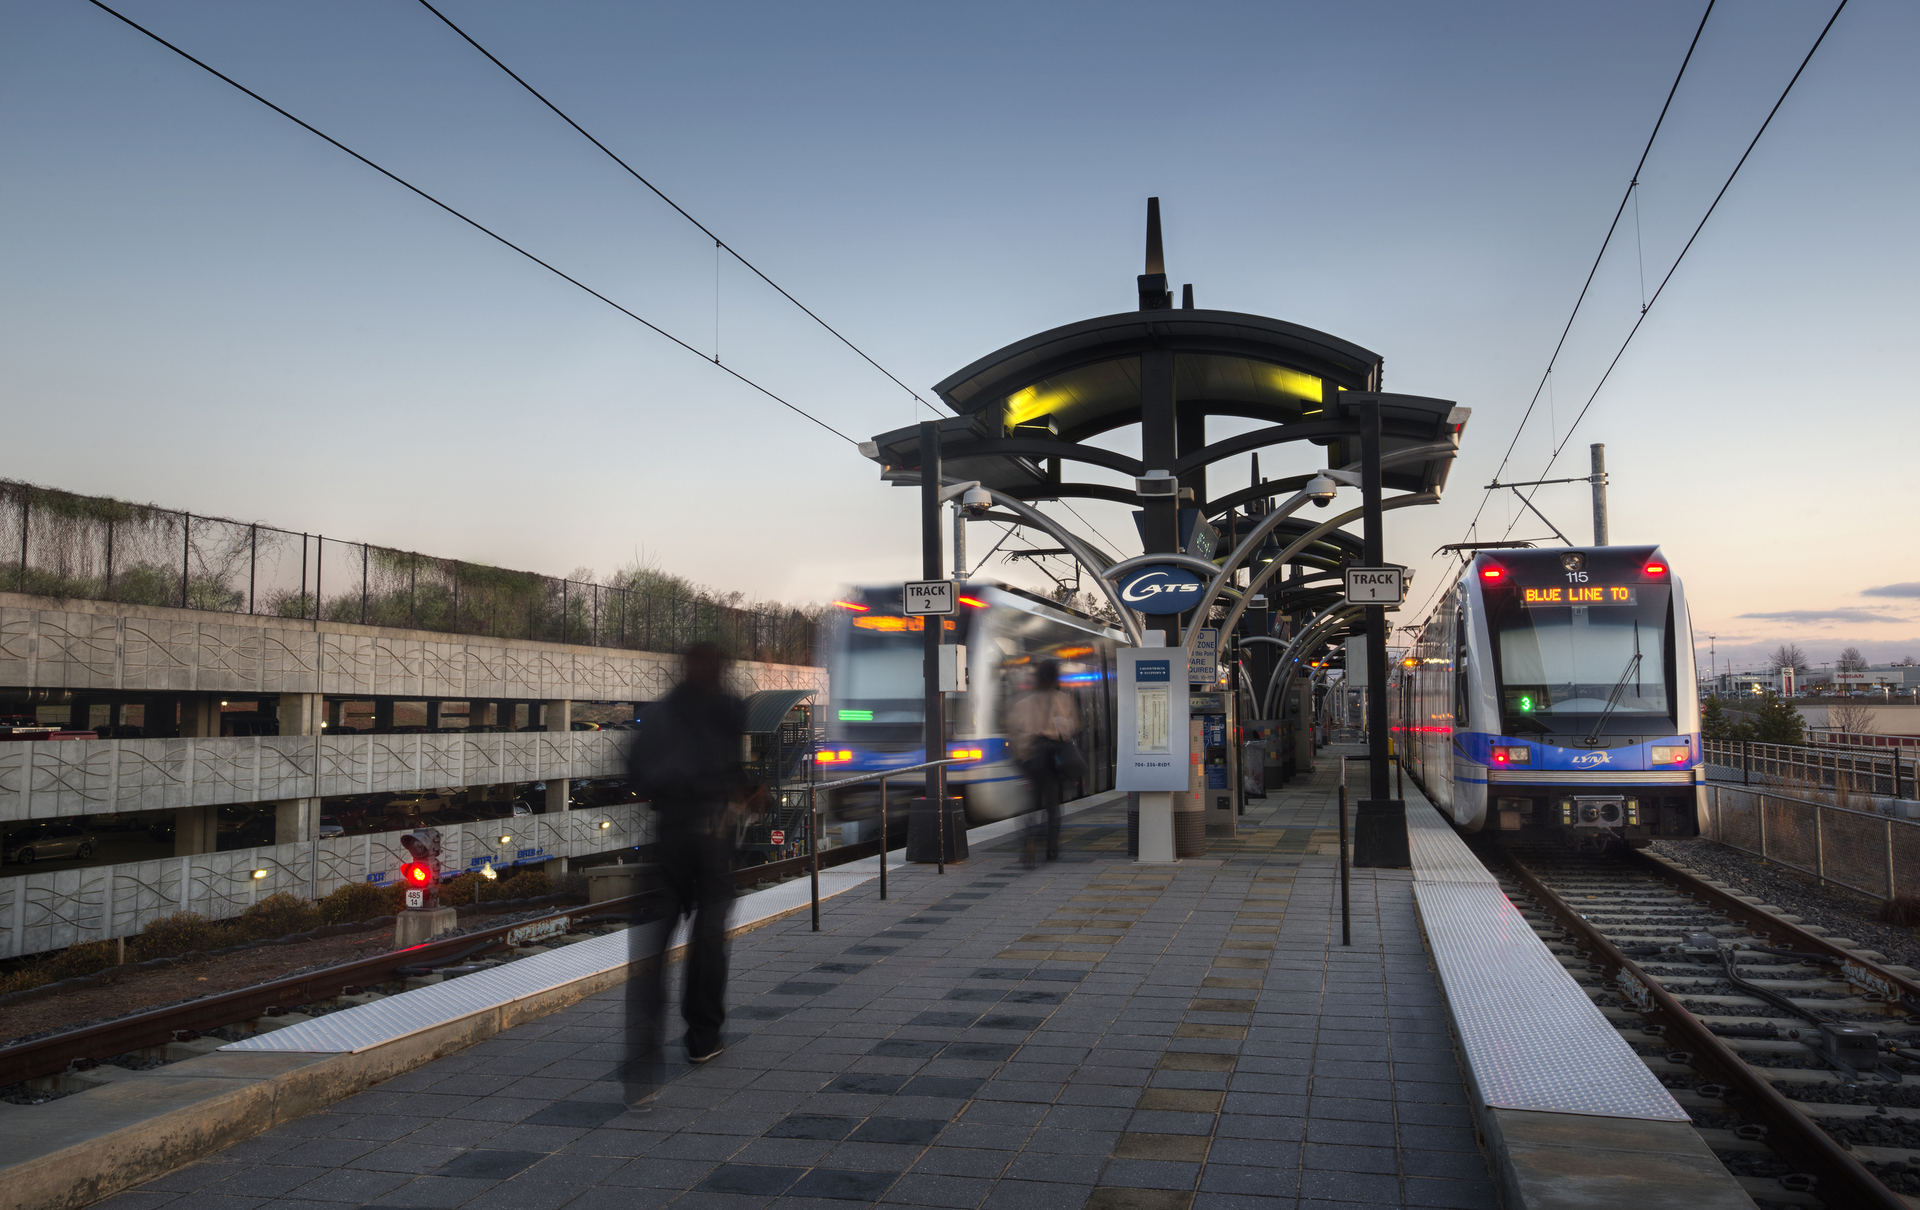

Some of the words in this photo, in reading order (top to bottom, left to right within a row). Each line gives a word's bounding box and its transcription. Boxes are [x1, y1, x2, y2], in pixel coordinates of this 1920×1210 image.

[1353, 574, 1393, 584] TRACK
[1566, 571, 1589, 583] 115
[909, 586, 946, 597] TRACK
[1122, 572, 1199, 602] CATS
[1369, 588, 1376, 598] 1
[1526, 588, 1561, 601] BLUE
[1569, 587, 1603, 601] LINE
[1610, 587, 1628, 600] TO
[924, 599, 931, 609] 2
[1197, 641, 1215, 649] ZONE
[1189, 666, 1214, 674] QUIRED
[1521, 697, 1530, 710] 3
[1571, 756, 1613, 764] LYNX
[367, 872, 386, 882] EXIT
[408, 891, 421, 899] 485
